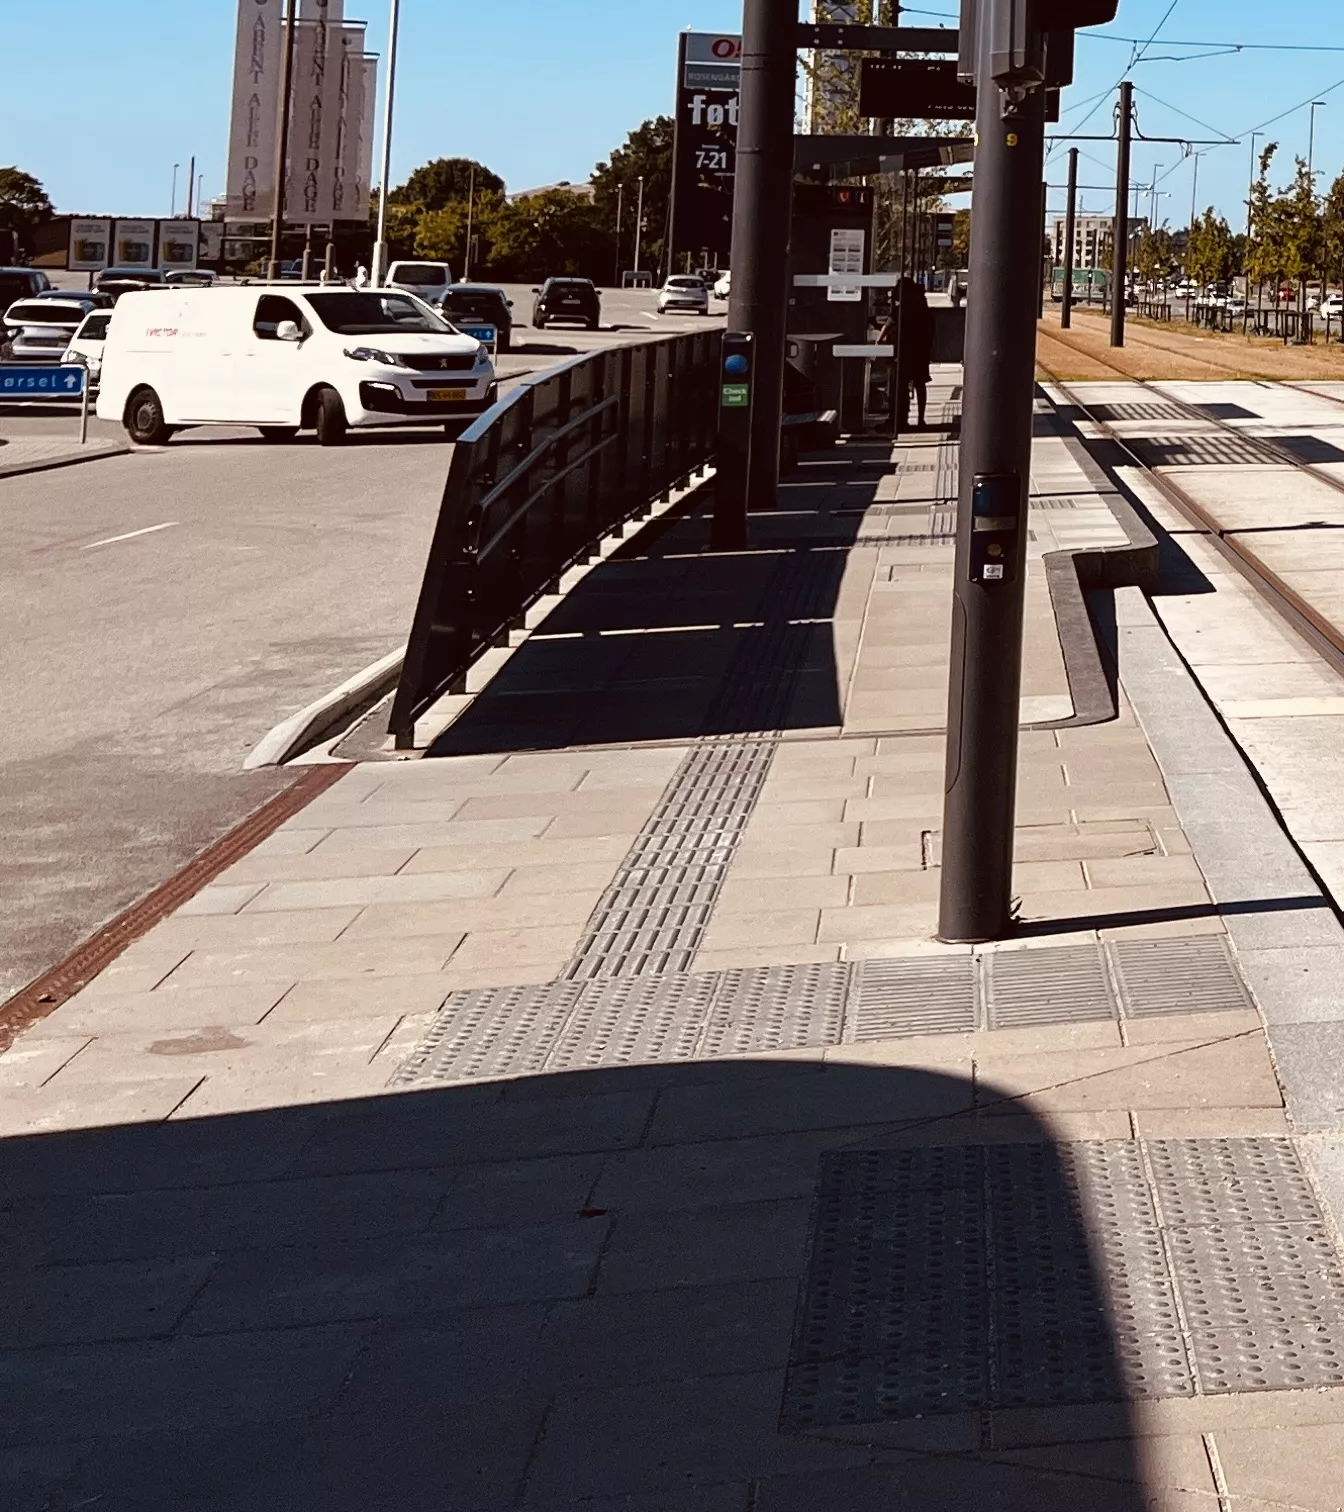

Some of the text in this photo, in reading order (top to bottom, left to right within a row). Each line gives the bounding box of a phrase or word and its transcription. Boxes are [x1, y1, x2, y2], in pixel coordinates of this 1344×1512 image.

[687, 94, 740, 126] føt
[1006, 133, 1018, 146] 9
[695, 150, 727, 169] 7-21
[242, 155, 258, 211] DAGE
[303, 157, 320, 213] DAGE
[722, 387, 748, 395] Check
